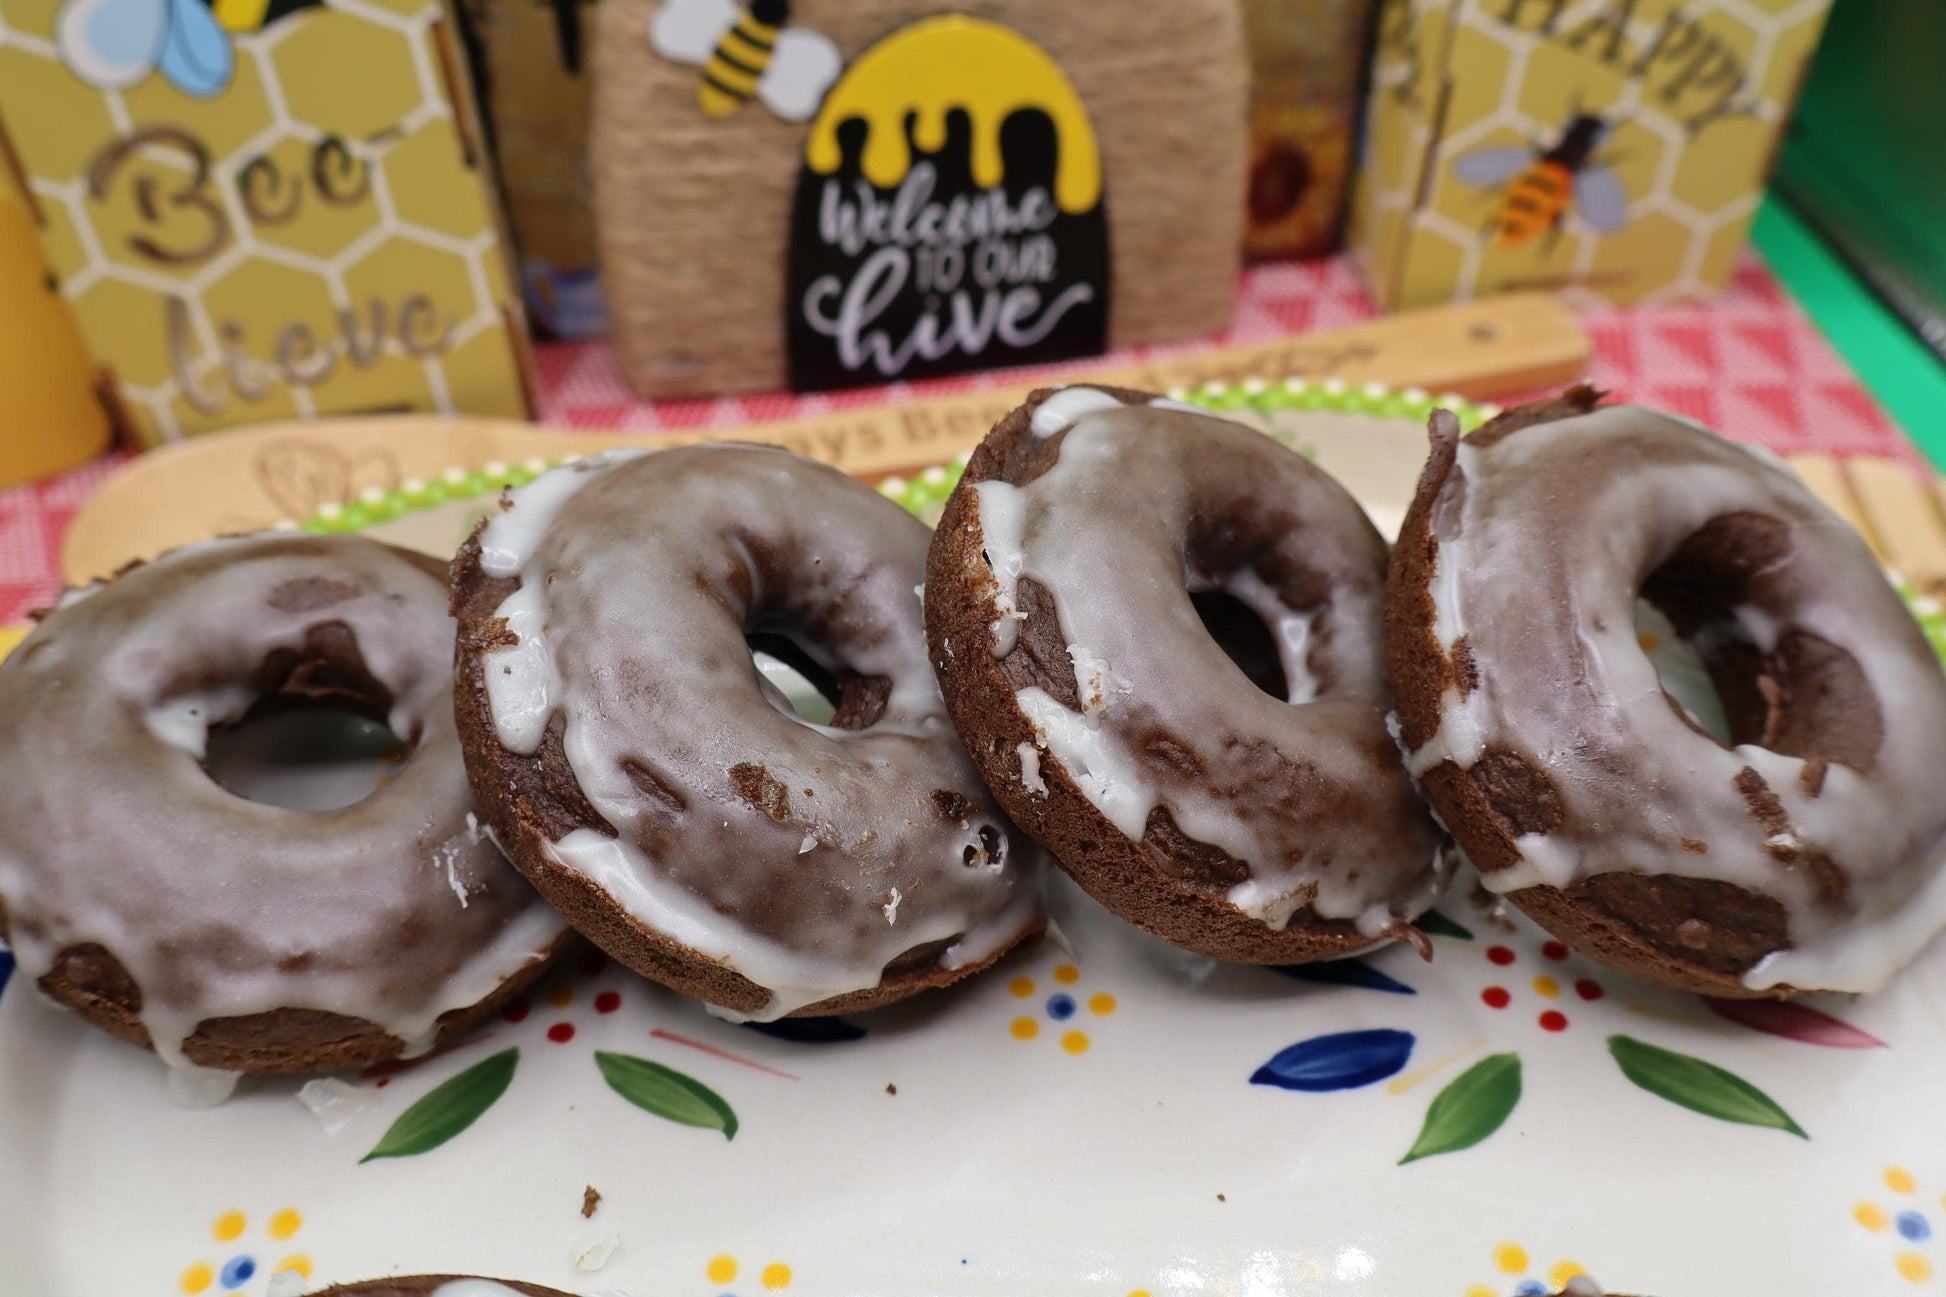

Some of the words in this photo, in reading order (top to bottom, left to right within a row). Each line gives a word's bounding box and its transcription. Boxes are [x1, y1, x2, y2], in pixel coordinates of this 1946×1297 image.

[818, 161, 1057, 256] Welcome
[163, 292, 456, 413] lieve
[802, 246, 1094, 376] hive
